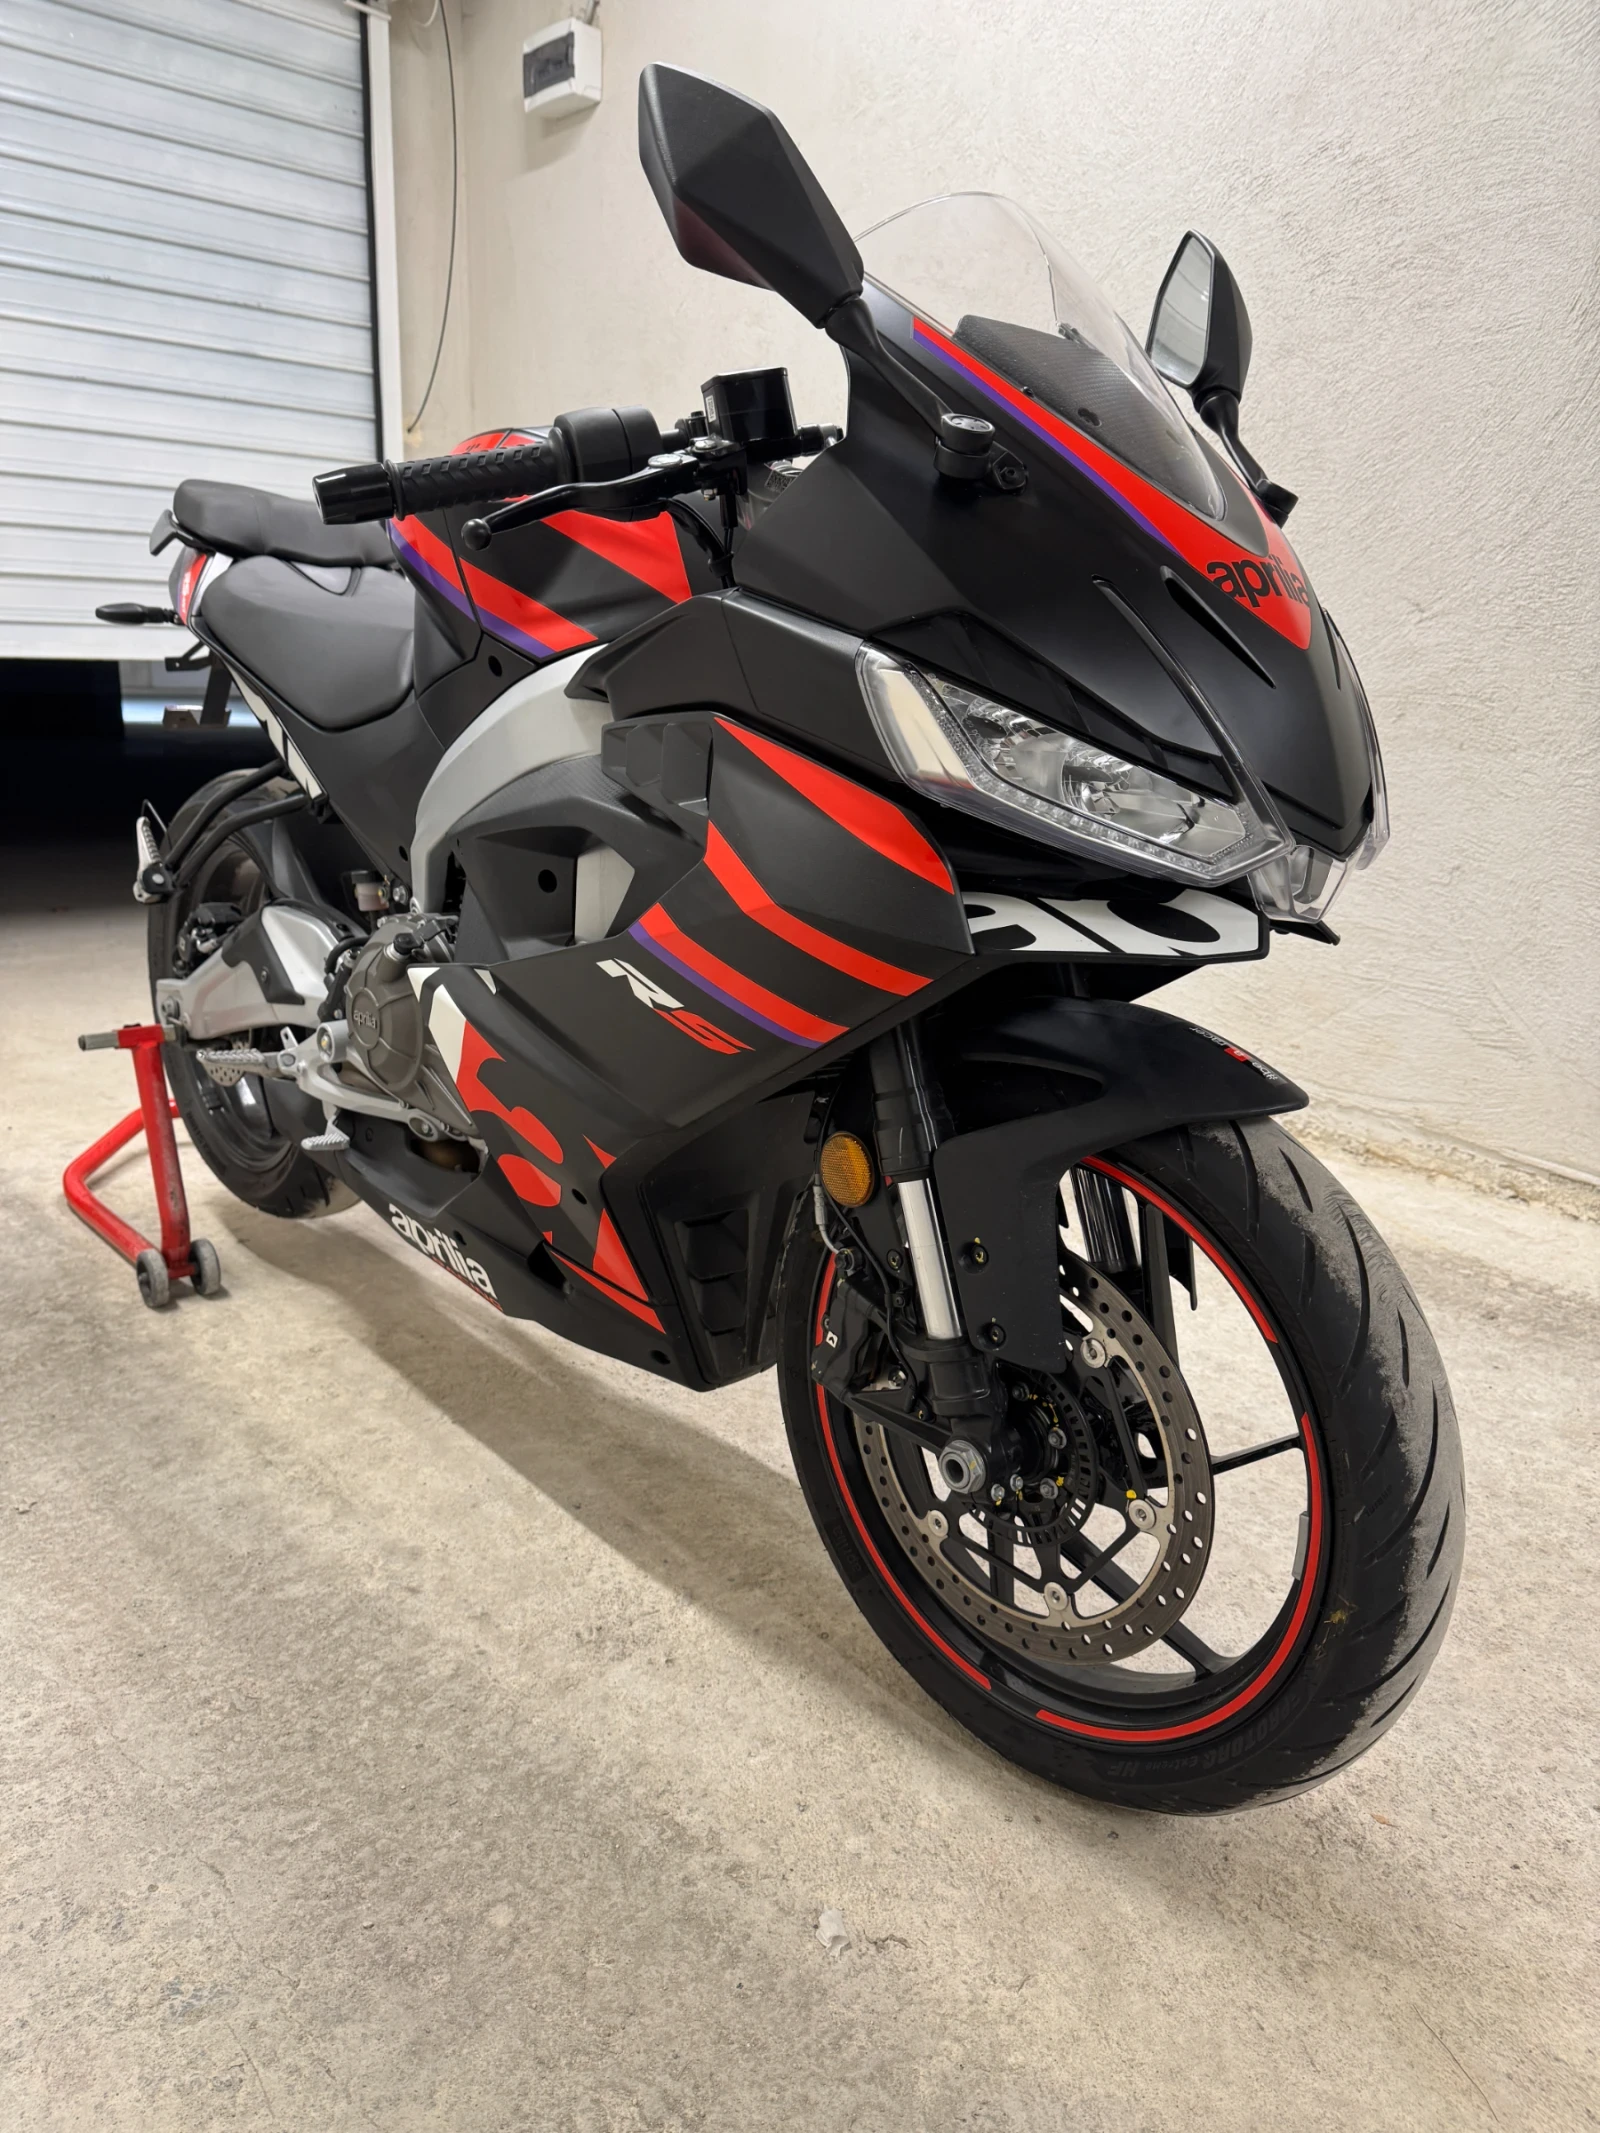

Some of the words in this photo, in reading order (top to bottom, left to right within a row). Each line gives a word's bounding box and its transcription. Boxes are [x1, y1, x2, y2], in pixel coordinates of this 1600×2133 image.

[1207, 553, 1310, 608] aprilia
[353, 1010, 378, 1029] aprilia
[389, 1203, 498, 1300] aprilia
